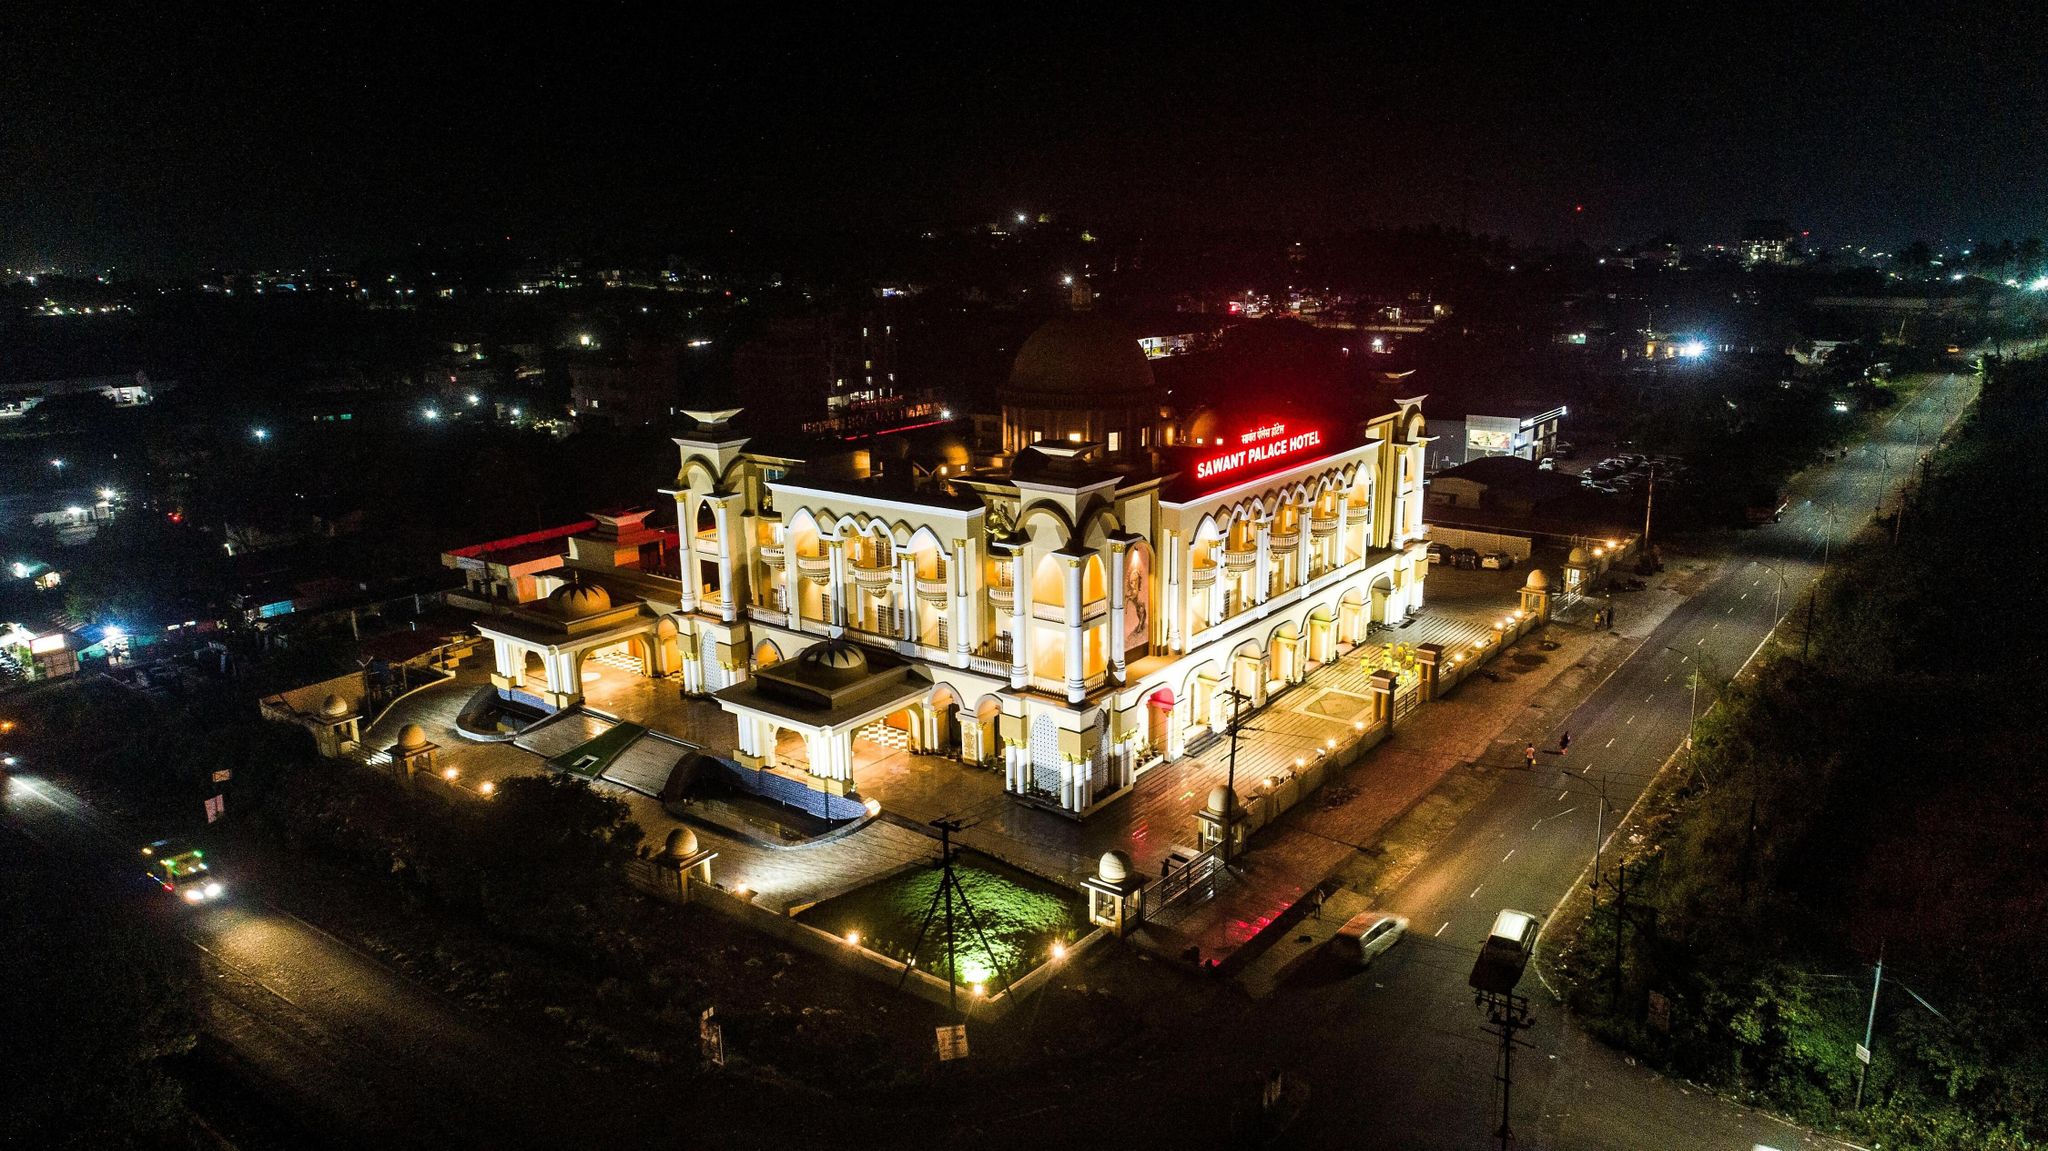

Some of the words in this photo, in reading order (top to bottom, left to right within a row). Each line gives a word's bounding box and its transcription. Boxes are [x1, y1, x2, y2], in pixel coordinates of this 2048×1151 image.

[1197, 451, 1246, 478] SAWANT
[1248, 440, 1287, 463] PALACE
[1290, 431, 1320, 451] HOTEL
